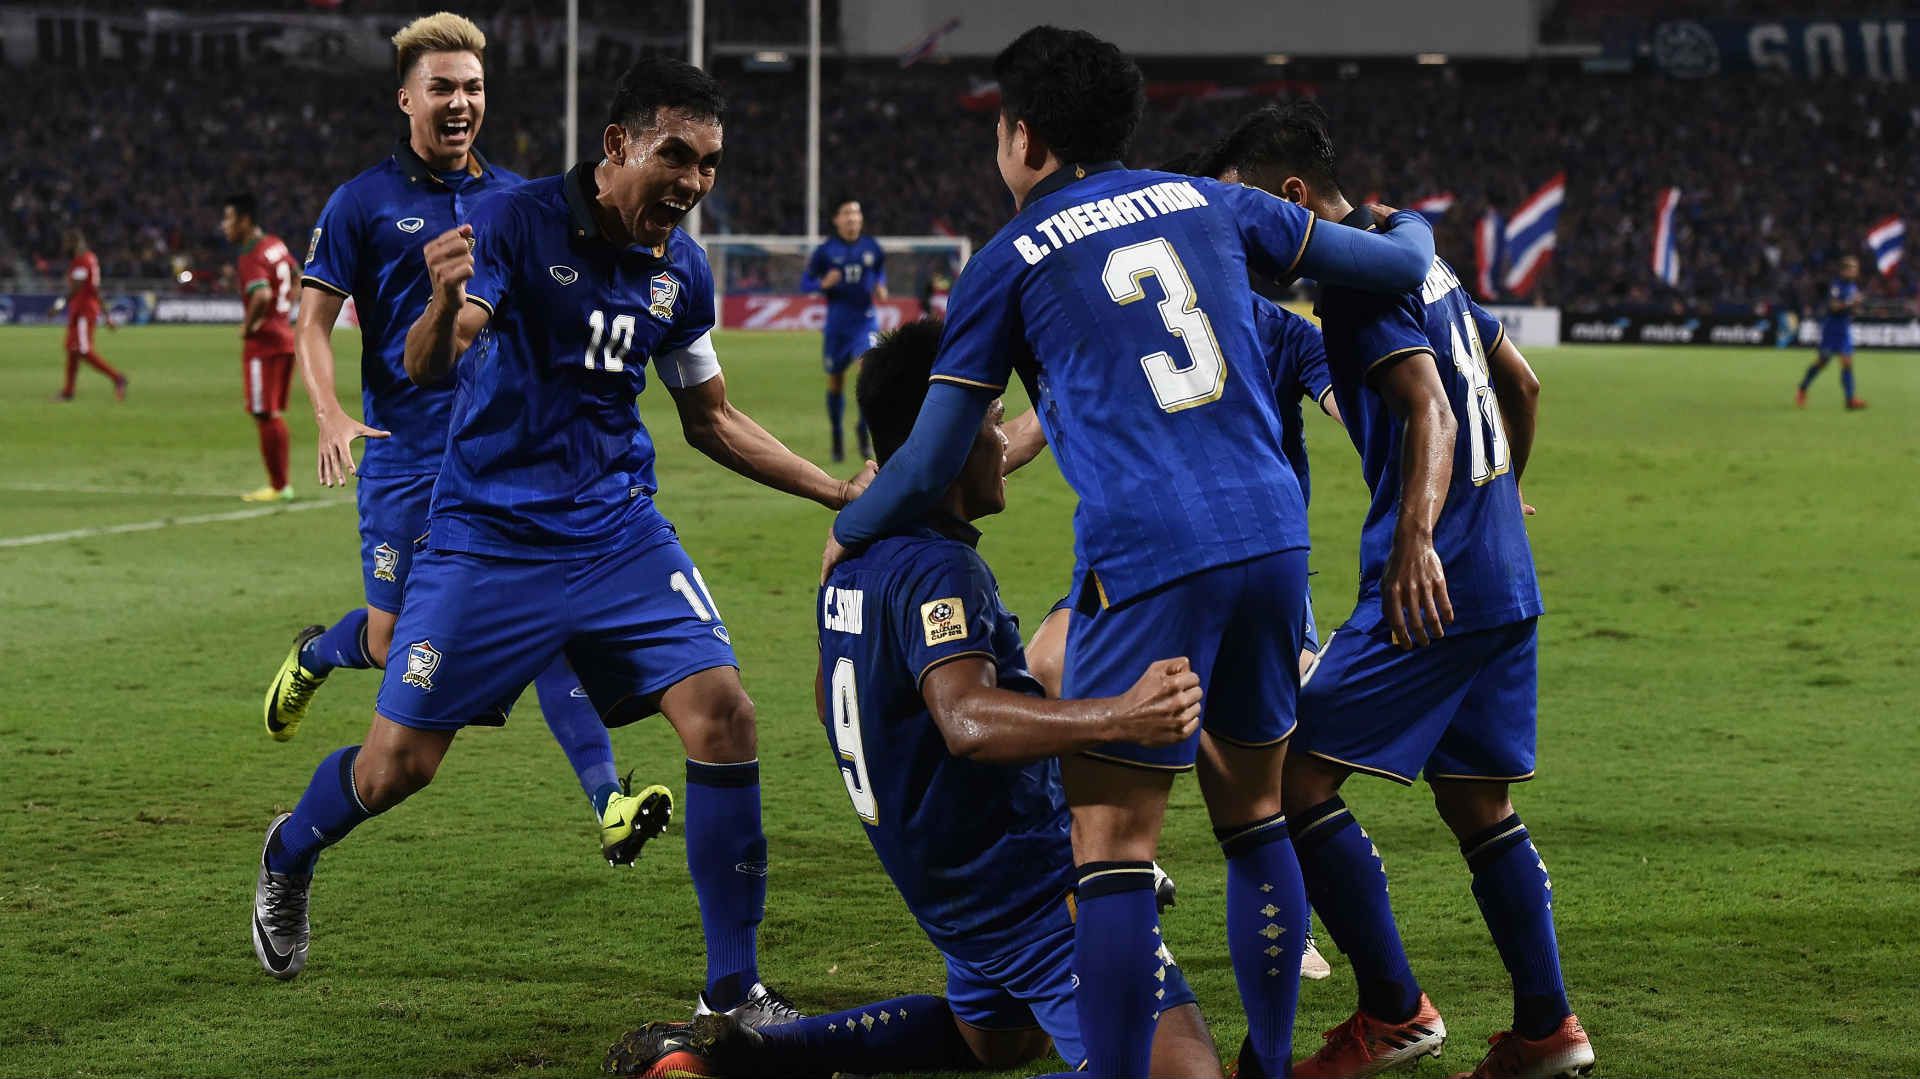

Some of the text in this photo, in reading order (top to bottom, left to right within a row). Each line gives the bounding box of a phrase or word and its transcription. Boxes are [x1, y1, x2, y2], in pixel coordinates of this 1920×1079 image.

[1013, 181, 1209, 266] B.THEERATHON
[585, 310, 636, 372] 10
[1102, 237, 1227, 413] 3
[931, 632, 948, 640] CUP
[832, 657, 879, 827] 9
